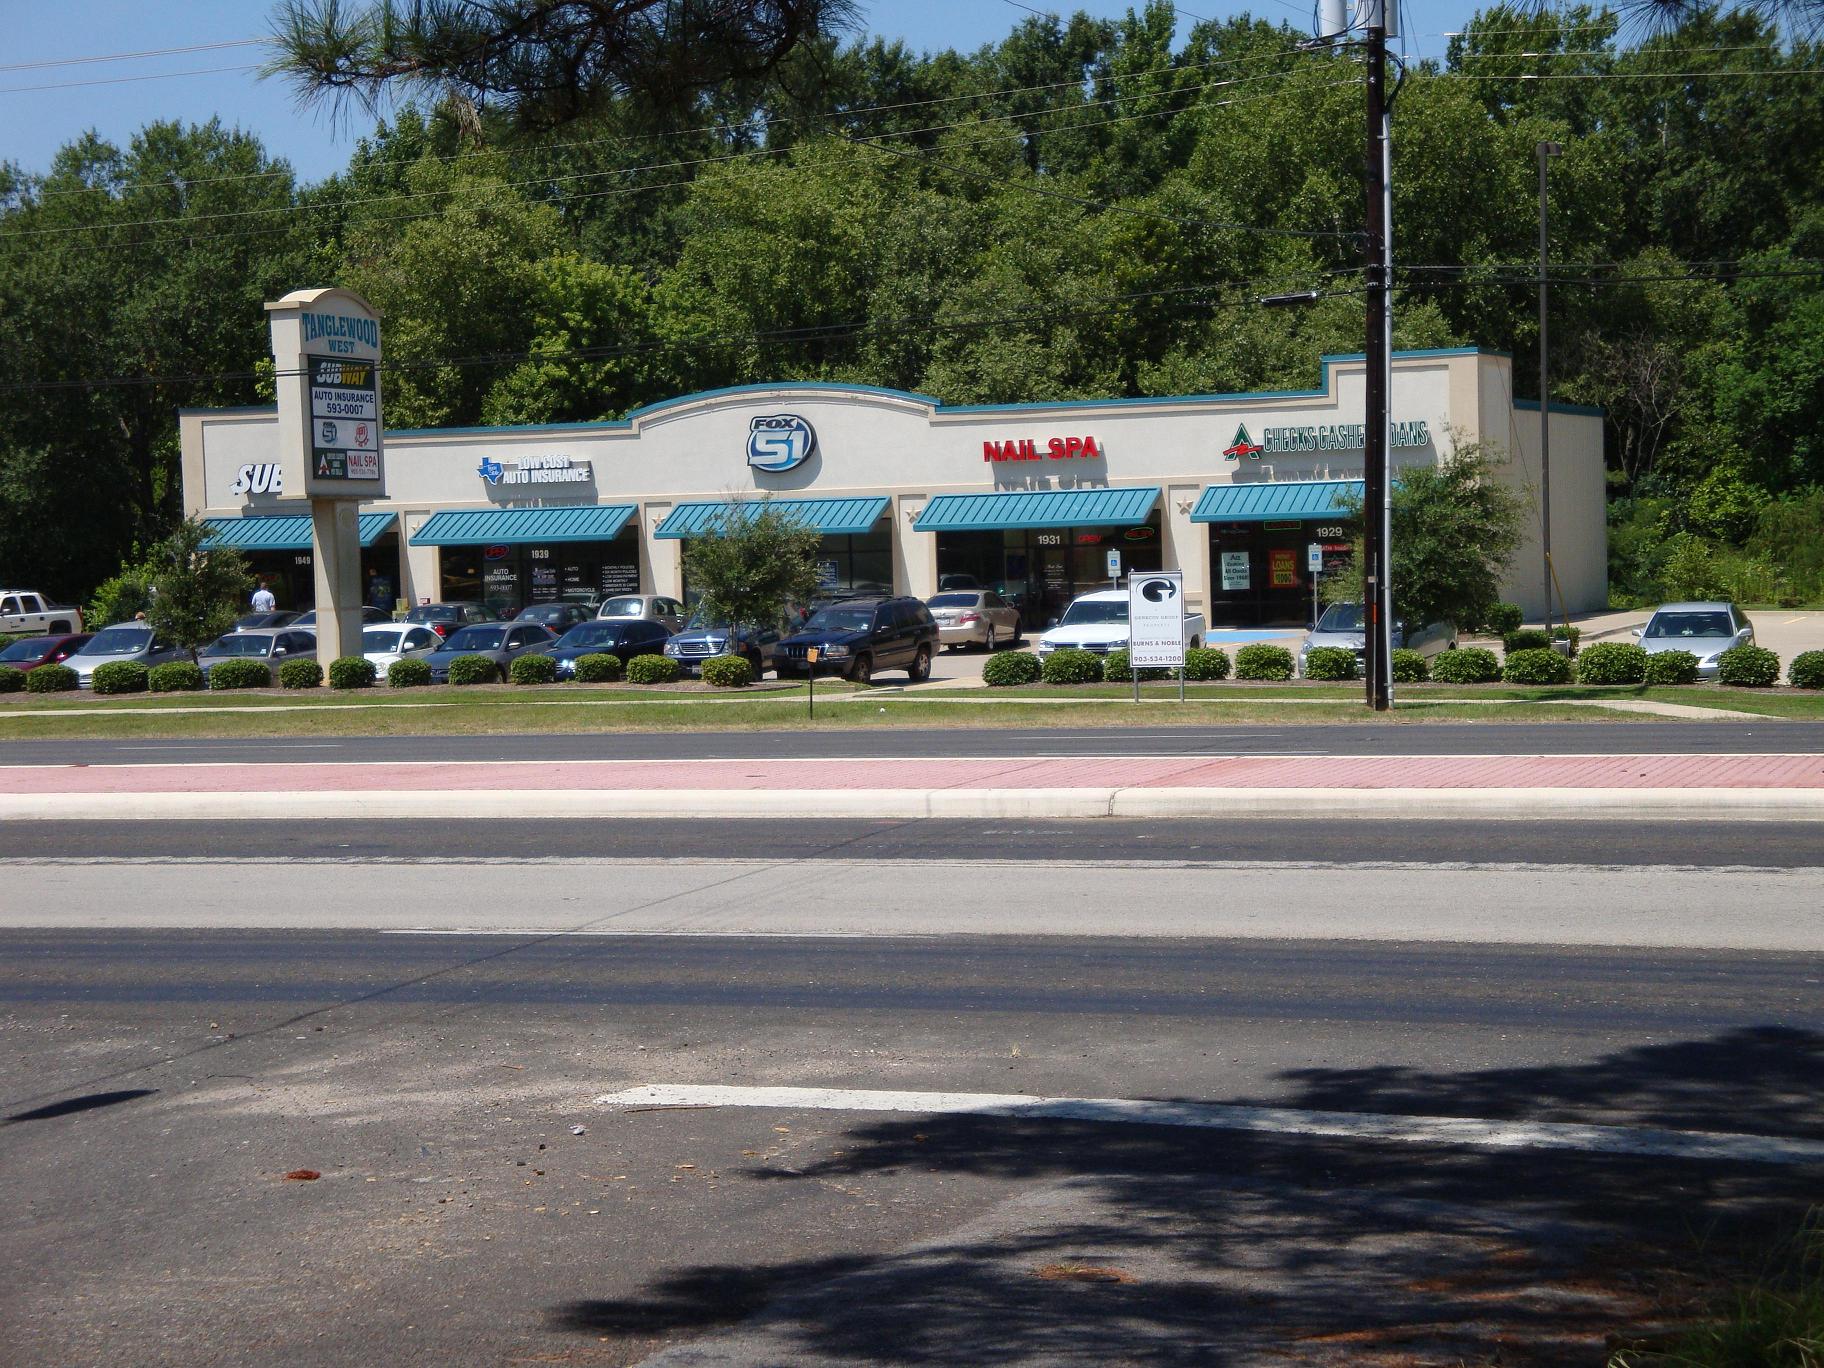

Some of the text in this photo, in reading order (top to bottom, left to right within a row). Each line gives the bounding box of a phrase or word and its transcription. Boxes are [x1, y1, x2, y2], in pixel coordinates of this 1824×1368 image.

[302, 312, 378, 348] TANGLEWOOD
[328, 339, 355, 353] WEST
[316, 361, 370, 385] SUBWAY
[314, 390, 374, 404] AUTO INSURANCE
[327, 402, 364, 415] 593-0007
[754, 418, 796, 430] FOX
[1263, 420, 1429, 453] CHECKS CASHE OANS
[750, 431, 805, 465] 51
[983, 436, 1099, 462] NAIL SPA
[348, 455, 364, 467] NAIL
[364, 455, 378, 468] SPA
[518, 455, 570, 469] LOW COST
[503, 470, 529, 484] AUTO
[531, 467, 591, 483] INSURANCE
[1316, 527, 1343, 537] 1929
[1038, 535, 1060, 545] 1931
[295, 556, 311, 565] 1949
[532, 549, 549, 559] 1939
[1272, 561, 1295, 571] LOANS
[485, 574, 517, 582] INSURANCE
